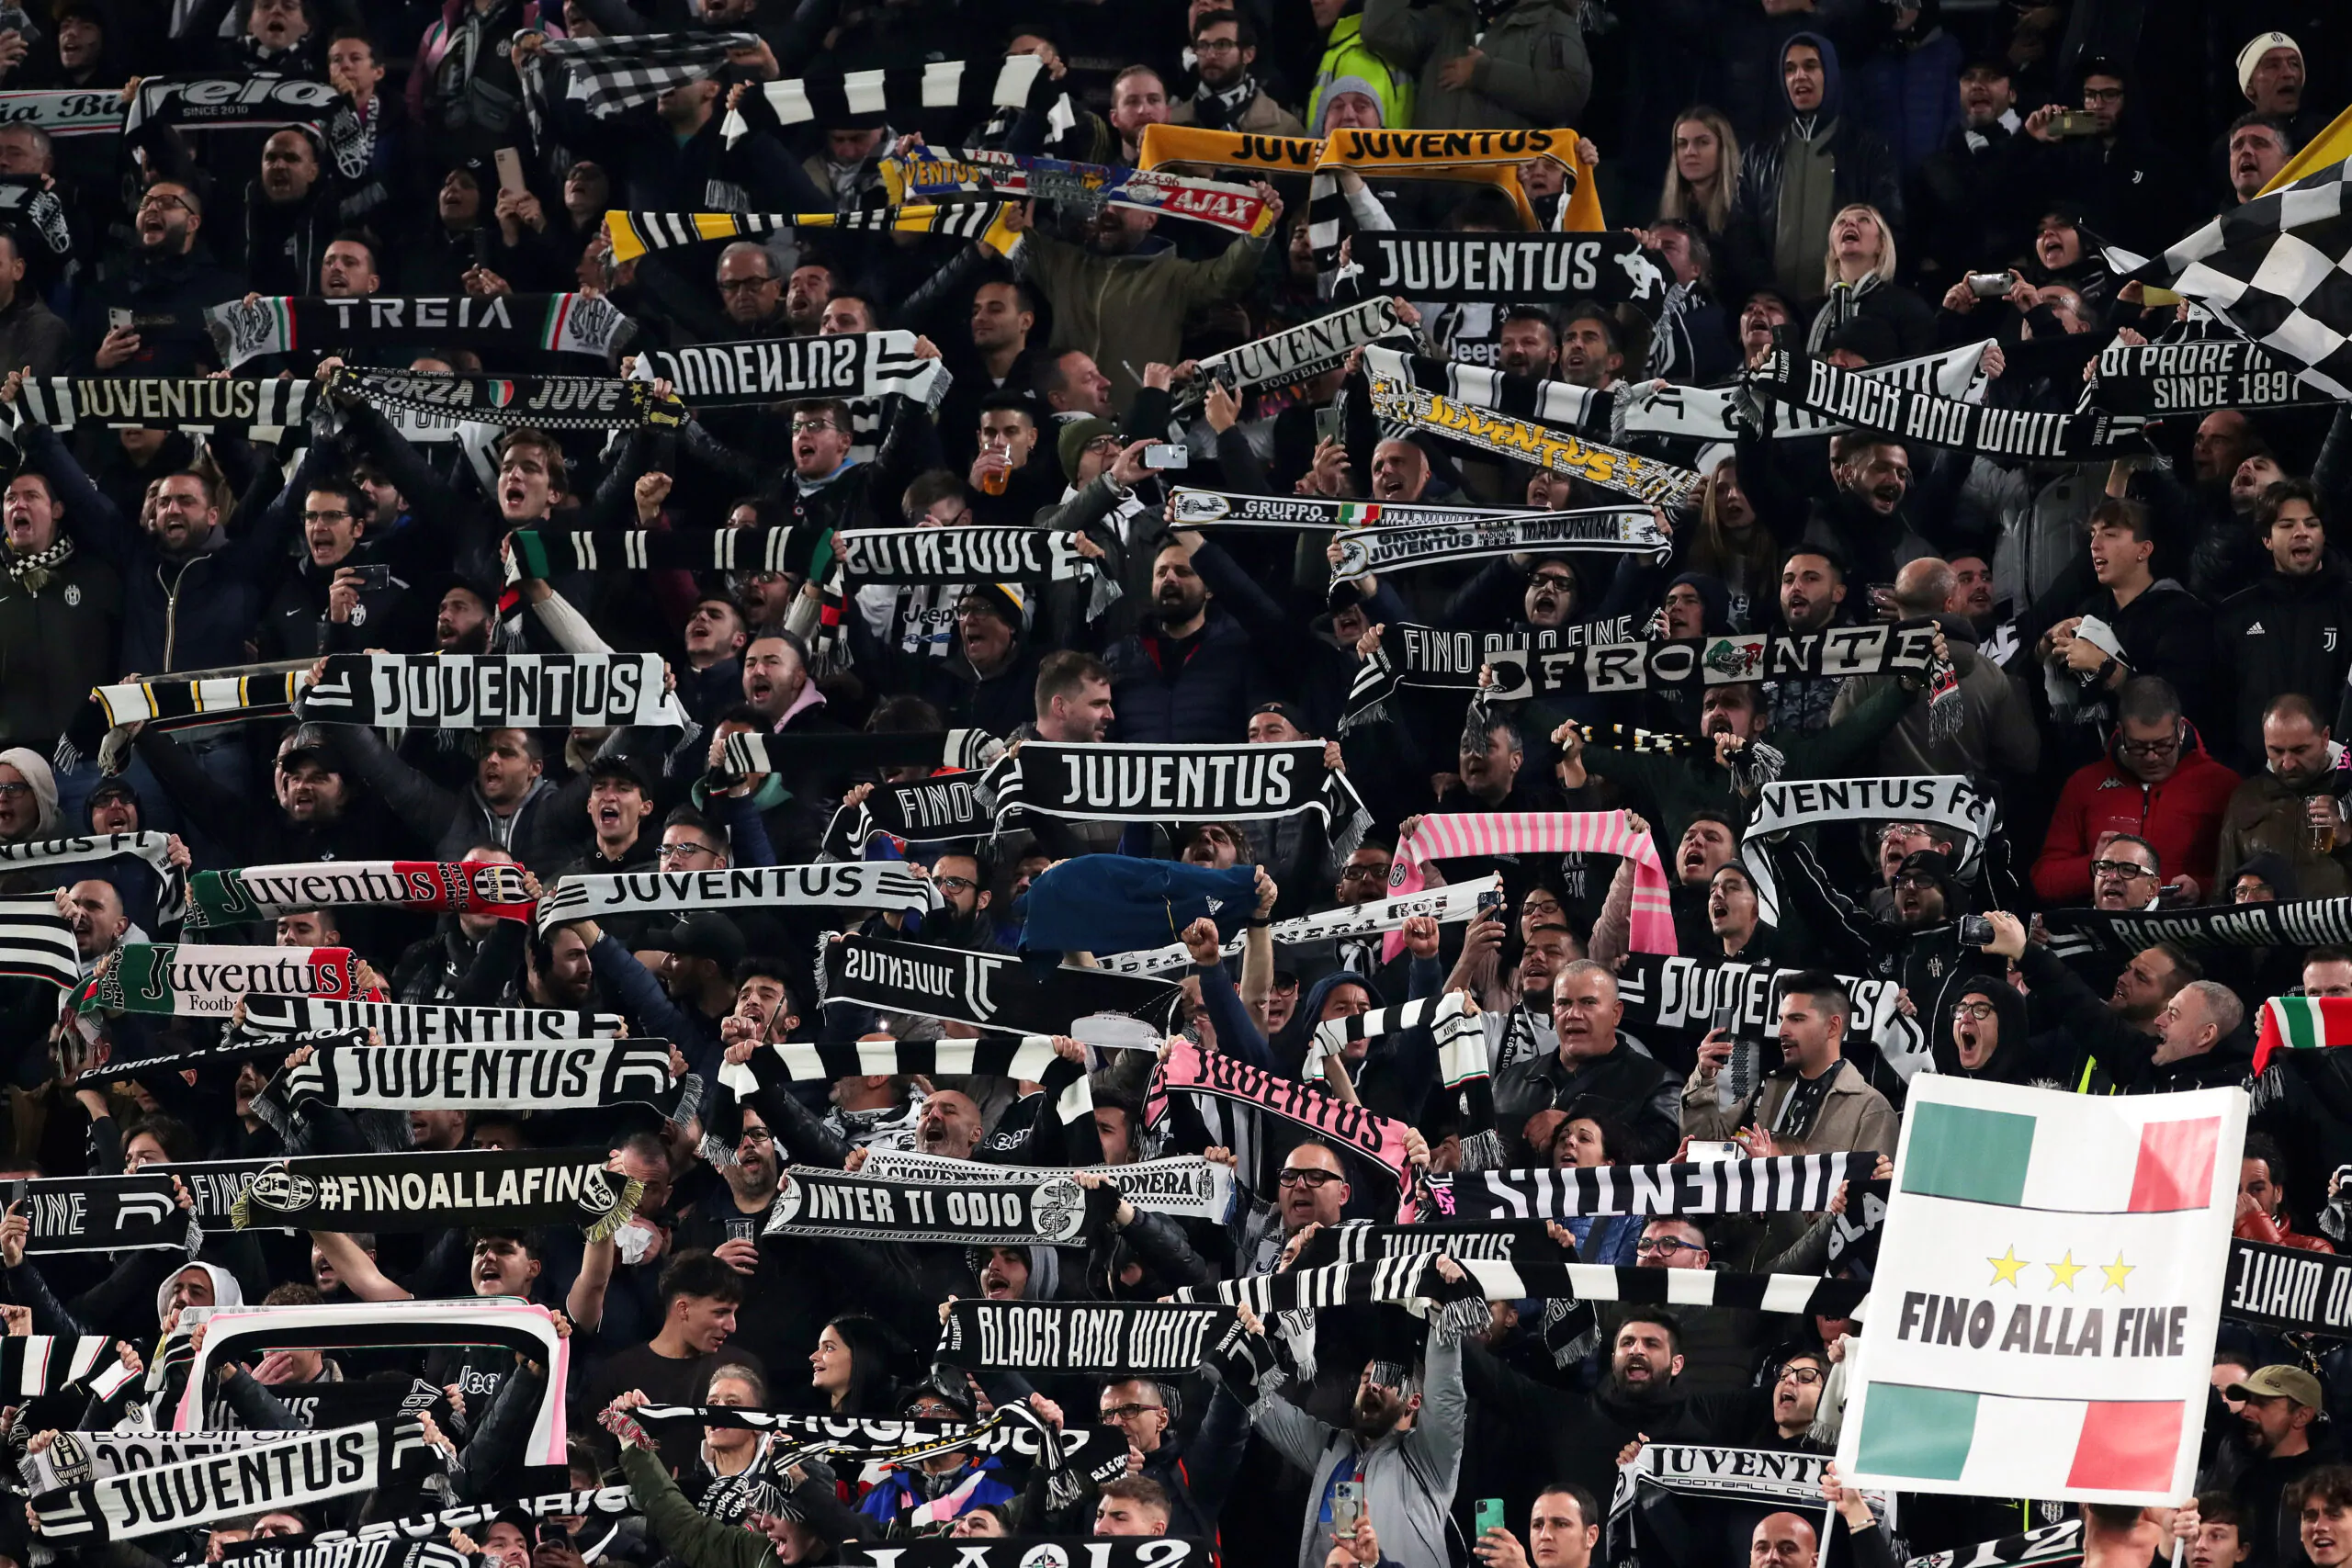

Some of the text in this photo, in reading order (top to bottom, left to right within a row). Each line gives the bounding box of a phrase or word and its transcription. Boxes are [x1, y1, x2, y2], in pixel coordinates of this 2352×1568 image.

[183, 104, 249, 117] SINCE 2010
[1230, 135, 1320, 165] JUV
[1346, 130, 1553, 160] JUVENTUS
[1173, 190, 1256, 223] AJAX
[1379, 240, 1600, 291] JUVENTUS
[323, 297, 512, 329] TREIA
[1452, 336, 1502, 367] Jeep
[2101, 349, 2132, 377] DI
[2140, 344, 2238, 377] PADRE
[361, 375, 474, 407] FORZA
[529, 380, 625, 411] JUVE
[1261, 362, 1335, 390] FOOTBALL
[2154, 374, 2228, 409] SINCE
[79, 379, 255, 419] JUVENTUS
[1806, 359, 1902, 431] BLACK
[1907, 394, 1971, 446] AND
[1976, 408, 2072, 457] WHITE
[1422, 394, 1618, 483] JUVENTUS
[1245, 500, 1323, 517] GRUPPO
[1521, 514, 1621, 543] MADUNINA
[1369, 533, 1475, 563] JUVENTUS
[903, 604, 954, 627] Jeep
[1404, 629, 1473, 673] FINO
[380, 662, 640, 716] JUVENTUS
[1063, 753, 1295, 806] JUVENTUS
[896, 782, 974, 829] FINO
[220, 867, 437, 914] Juventus
[605, 865, 867, 905] JUVENTUS
[2278, 896, 2352, 946] WHIT
[141, 945, 343, 999] Juventus
[353, 1047, 593, 1099] JUVENTUS
[1193, 1046, 1389, 1153] JUVENTUS
[808, 1183, 1022, 1227] INTER TI ODIO
[979, 1306, 1062, 1367] BLACK
[1068, 1307, 1122, 1368] AND
[1127, 1310, 1218, 1368] WHITE
[1896, 1290, 2188, 1358] FINO ALLA FINE
[109, 1431, 366, 1528] JUVENTUS
[1663, 1478, 1779, 1493] FOOTBALL
